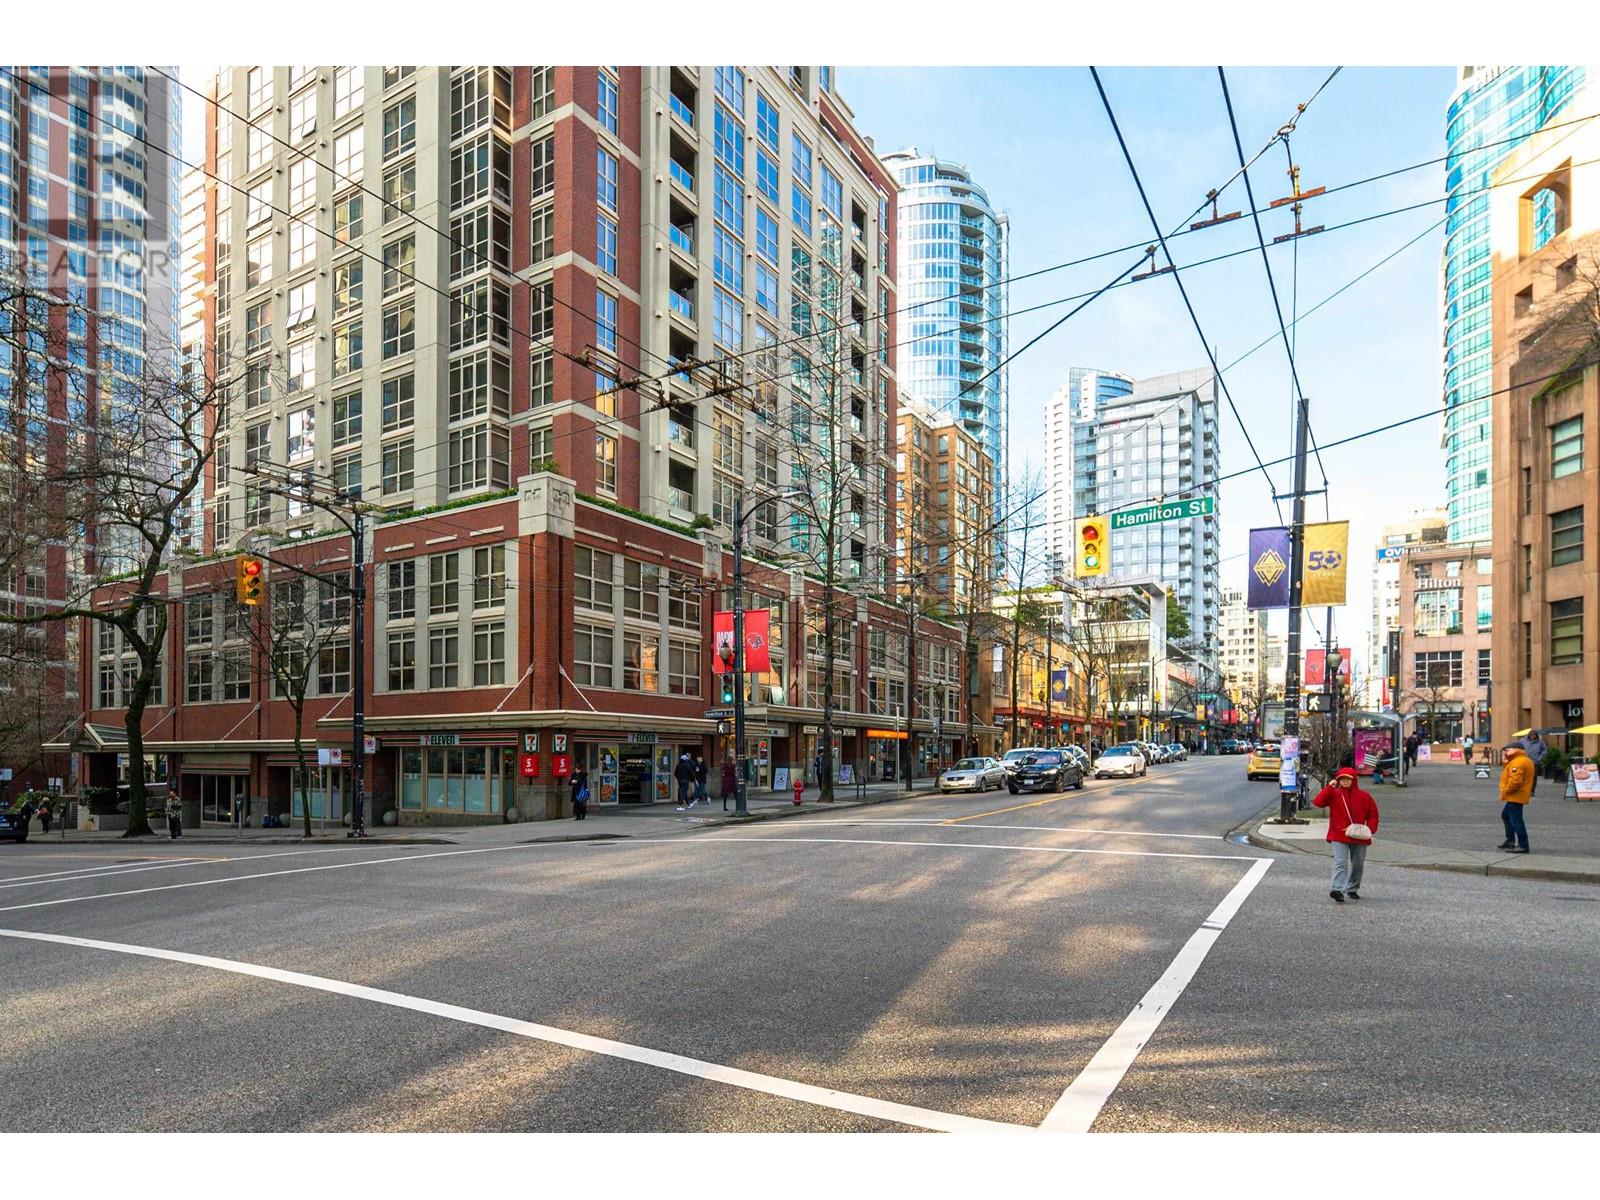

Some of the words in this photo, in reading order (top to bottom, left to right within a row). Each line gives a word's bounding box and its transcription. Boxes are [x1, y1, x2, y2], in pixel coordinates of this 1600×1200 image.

[1116, 506, 1182, 527] Hamilton
[1189, 500, 1207, 514] St
[1308, 550, 1342, 571] 50
[1417, 577, 1462, 589] Hilton
